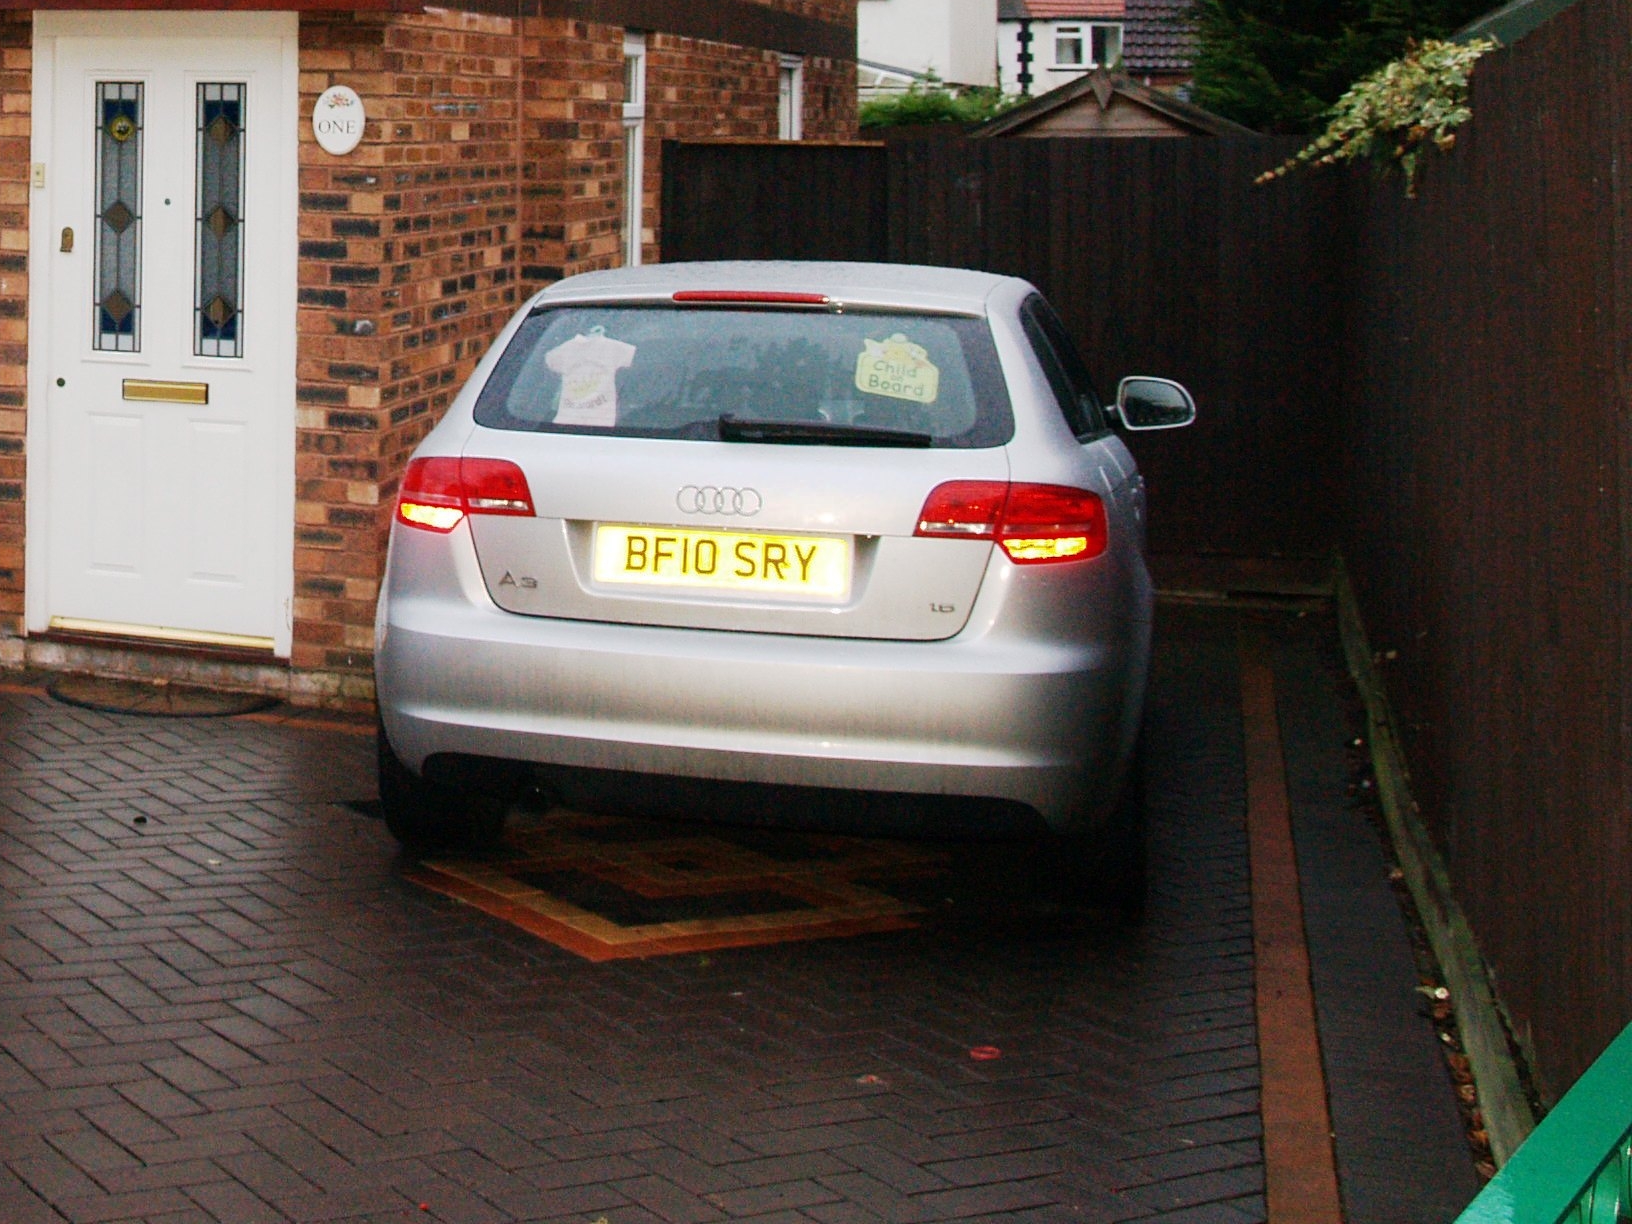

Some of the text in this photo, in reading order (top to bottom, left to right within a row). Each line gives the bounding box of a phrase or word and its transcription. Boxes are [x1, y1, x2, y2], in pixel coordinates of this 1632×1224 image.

[318, 119, 357, 135] ONE
[873, 359, 918, 378] Child
[868, 373, 925, 397] Board
[624, 535, 817, 581] BF10 SRY
[498, 570, 539, 589] A3
